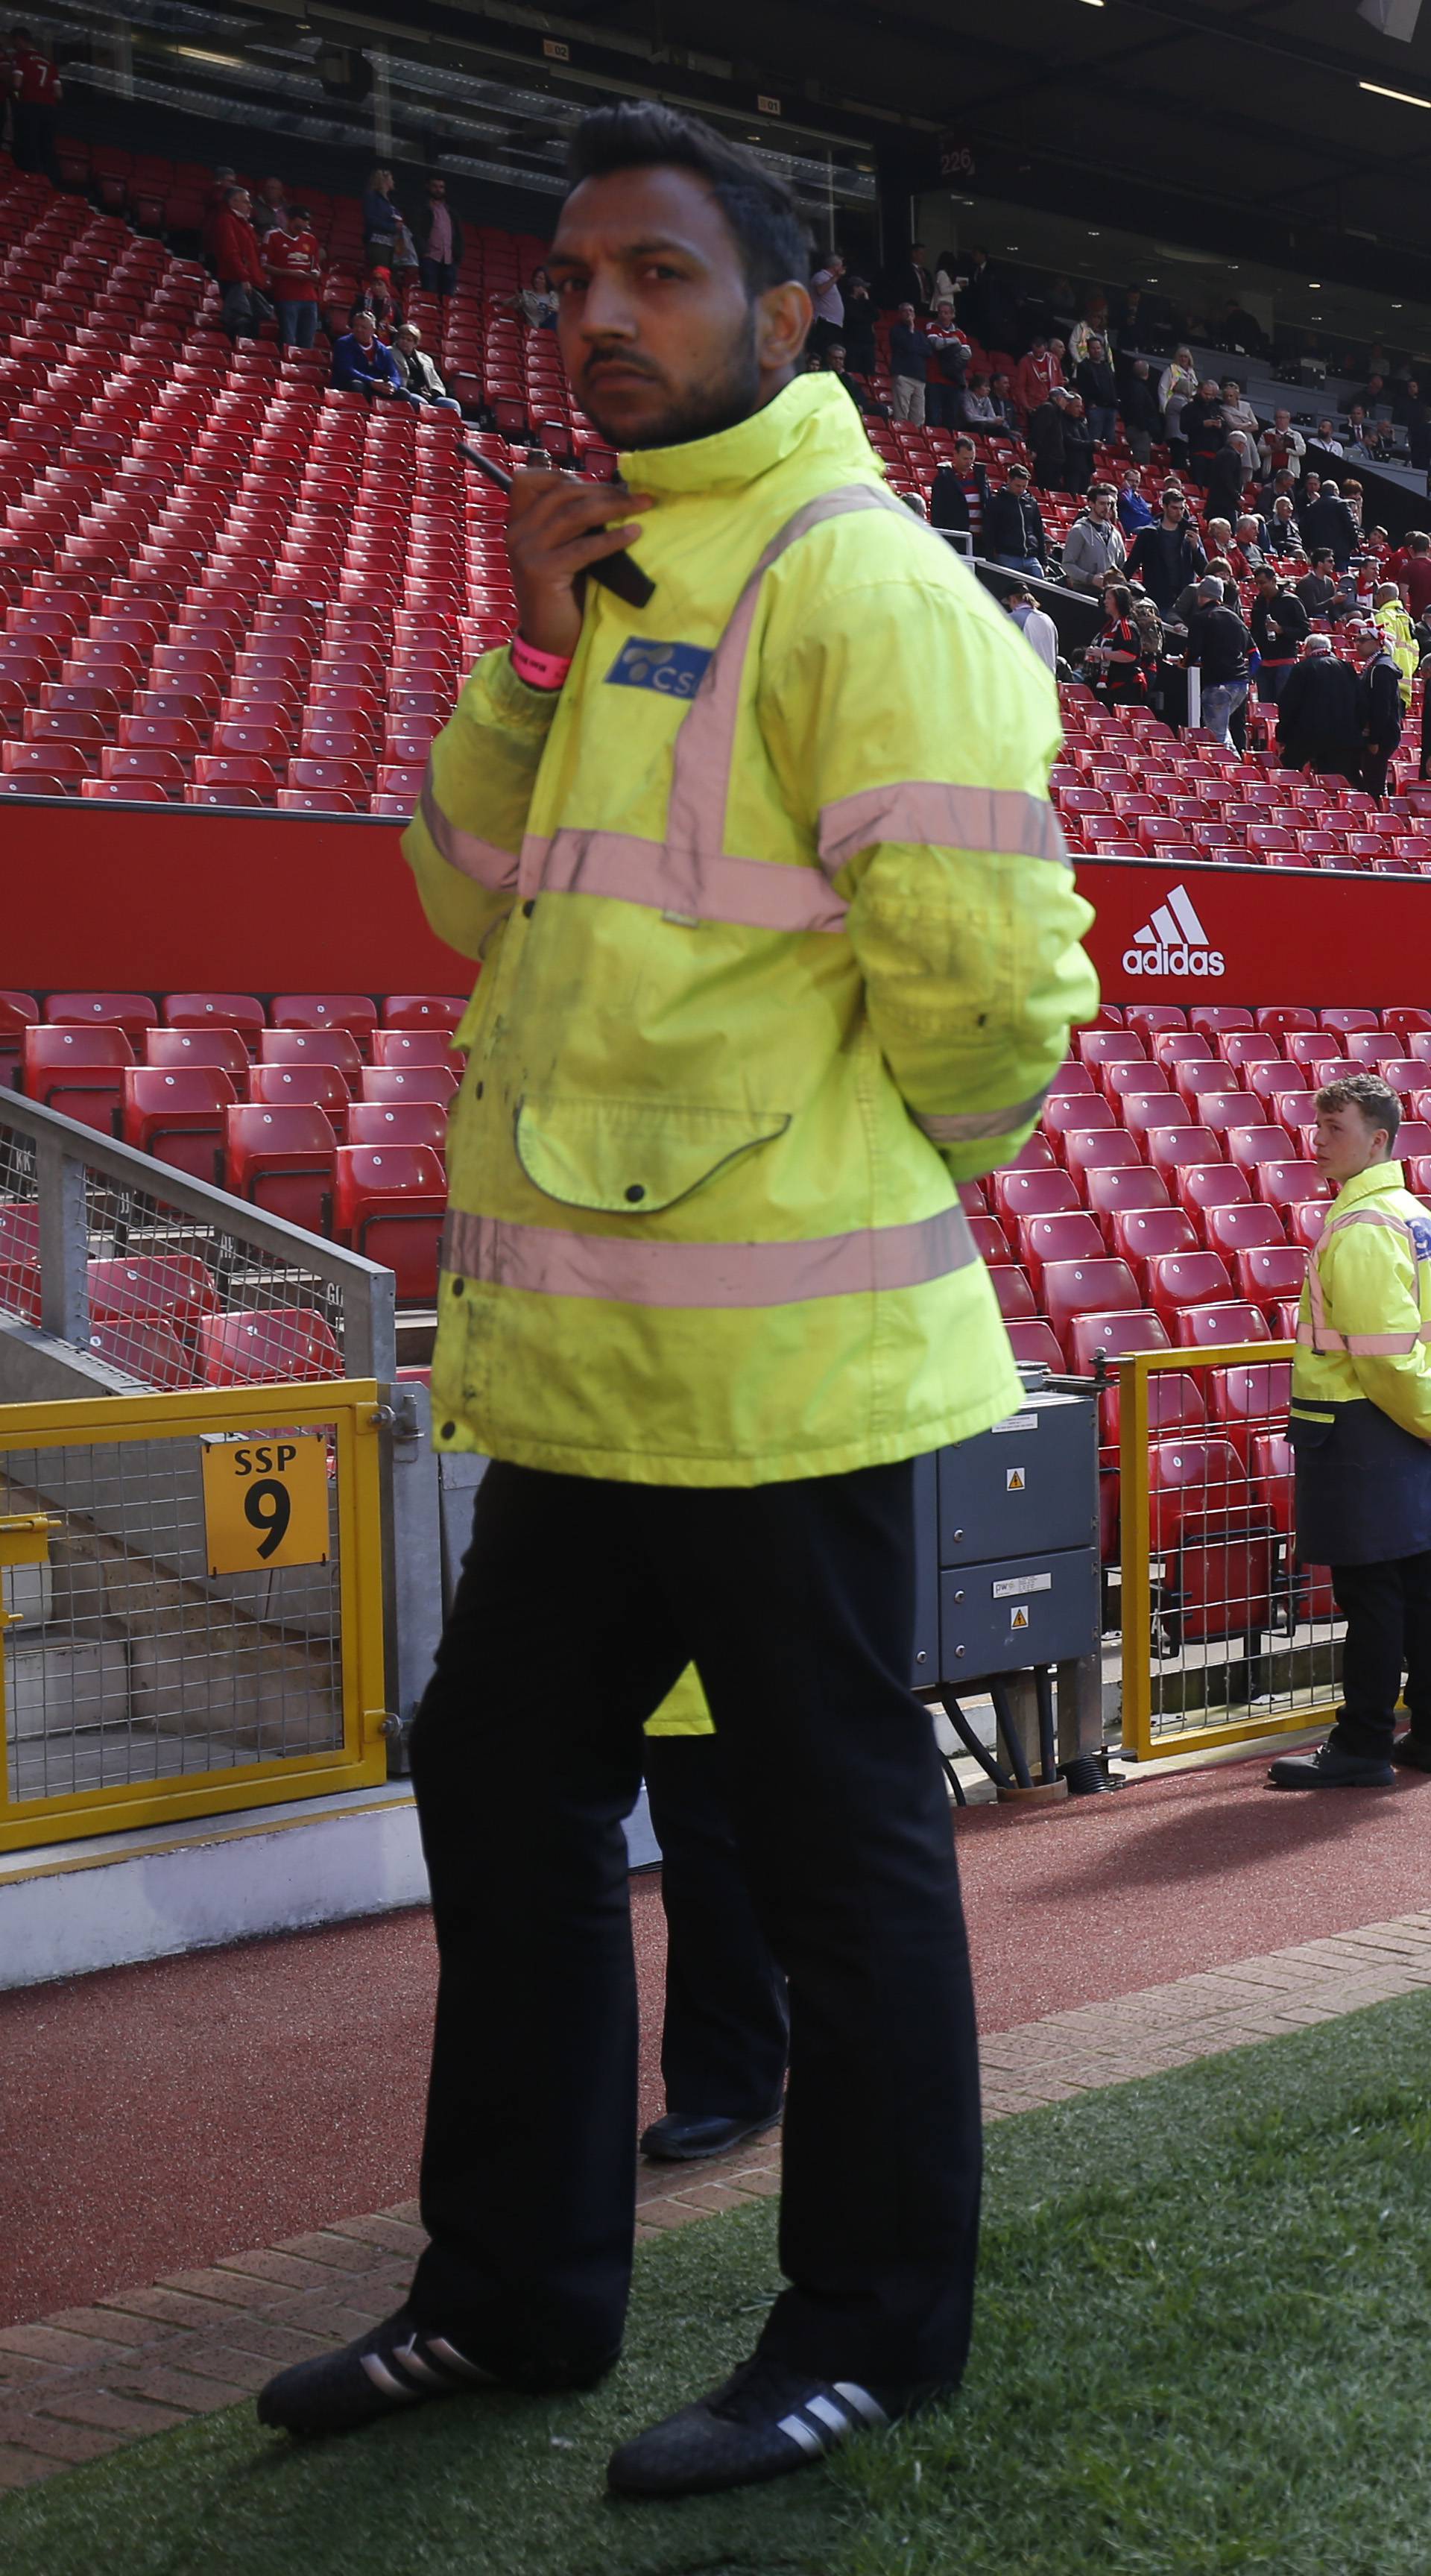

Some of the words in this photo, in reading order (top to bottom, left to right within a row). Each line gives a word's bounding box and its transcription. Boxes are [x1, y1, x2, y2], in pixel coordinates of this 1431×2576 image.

[941, 147, 972, 175] 226
[1122, 942, 1225, 976] adidas
[234, 1445, 297, 1476] SSP
[244, 1478, 291, 1560] 9
